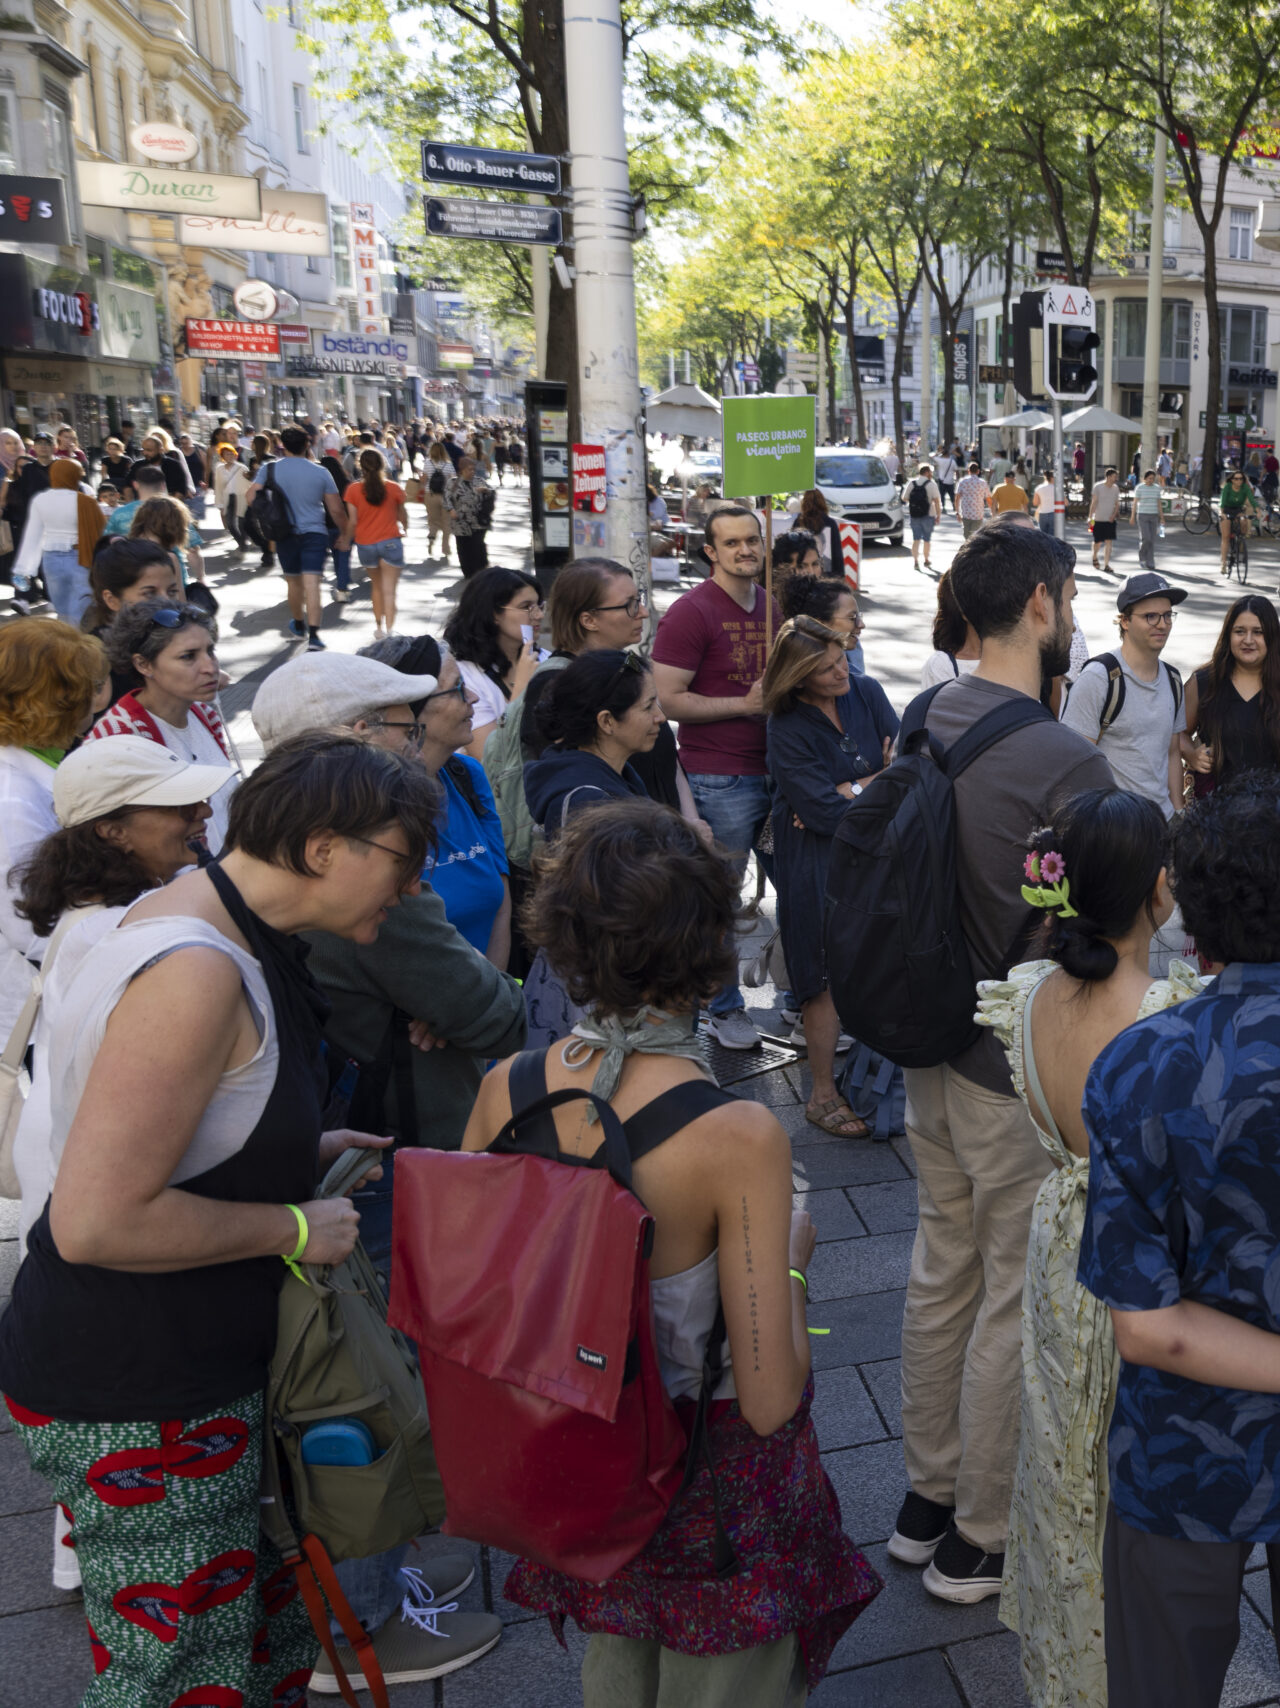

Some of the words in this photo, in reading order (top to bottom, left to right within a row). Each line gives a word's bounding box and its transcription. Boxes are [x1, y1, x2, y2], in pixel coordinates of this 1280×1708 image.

[446, 157, 556, 183] Otto-Bauer-Gasse
[119, 171, 219, 203] Duran
[39, 288, 83, 327] FOCUS
[188, 320, 277, 336] KLAVIERE
[1193, 312, 1201, 351] NOTAR
[322, 334, 408, 361] bständig
[954, 343, 967, 380] snipes
[736, 431, 770, 442] PASEOS
[771, 429, 807, 441] URBANOS
[572, 452, 606, 471] Kronen
[574, 472, 607, 493] Zeitung
